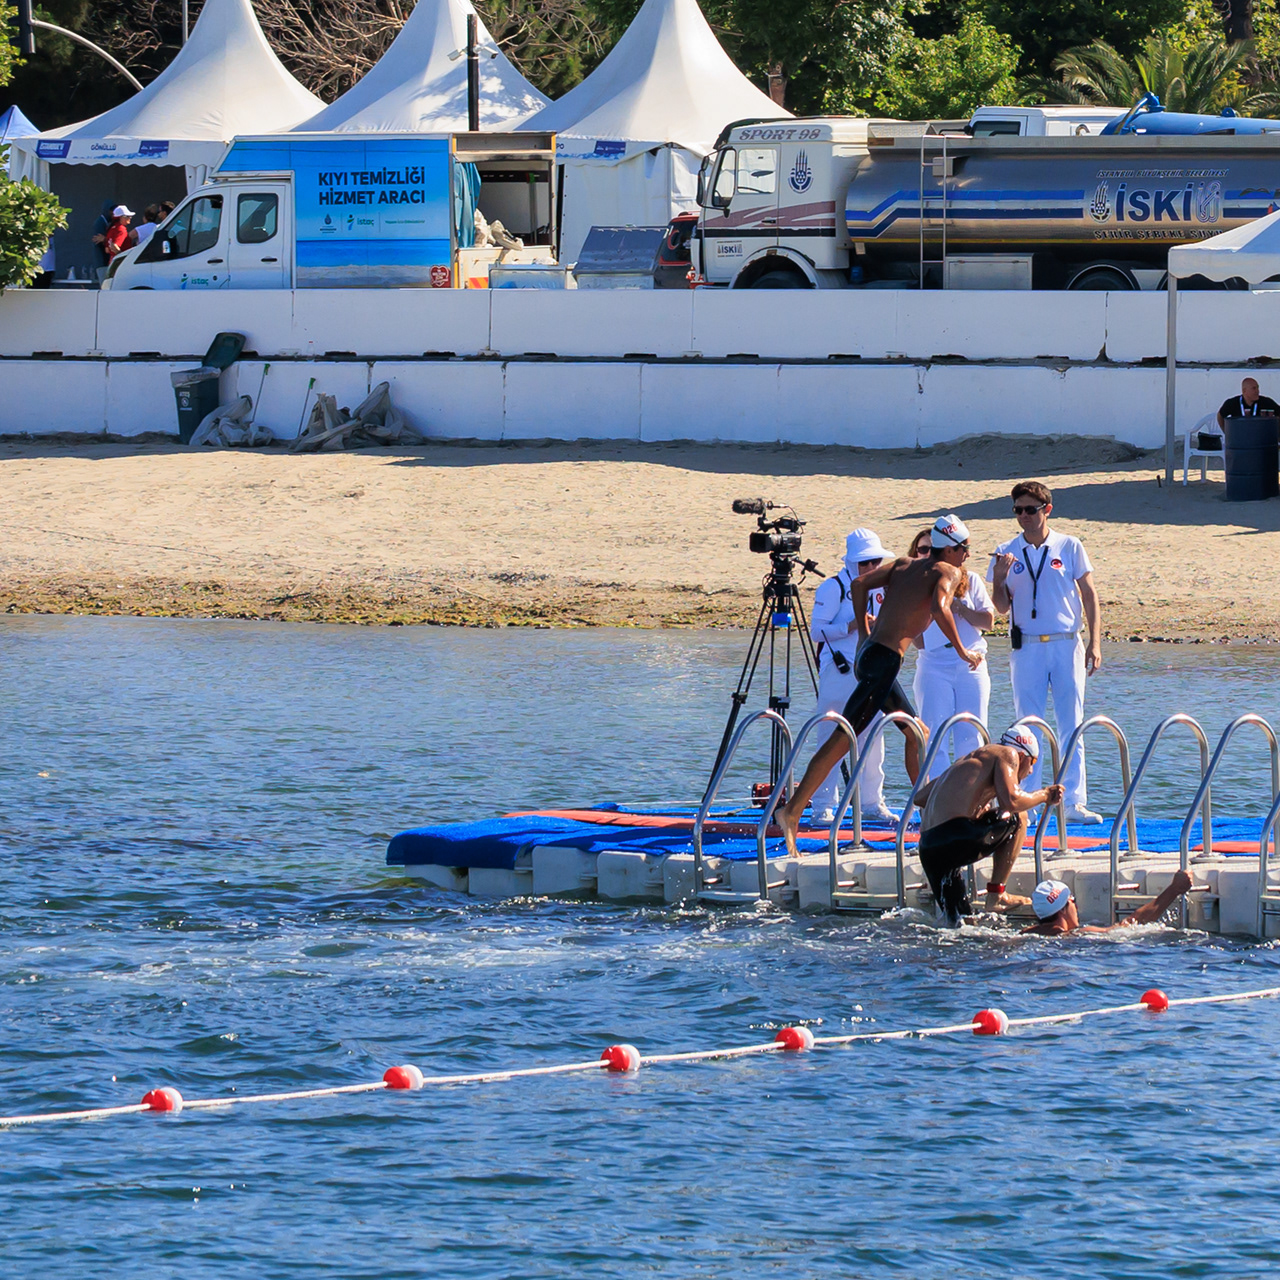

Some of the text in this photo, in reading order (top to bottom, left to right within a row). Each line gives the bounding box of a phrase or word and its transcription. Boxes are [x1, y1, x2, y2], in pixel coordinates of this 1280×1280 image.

[739, 129, 821, 140] SPORT 98
[318, 166, 425, 186] KIYI TEMİZLİĞİ
[318, 187, 425, 205] HİZMET ARACI
[1115, 182, 1194, 222] İSKİ
